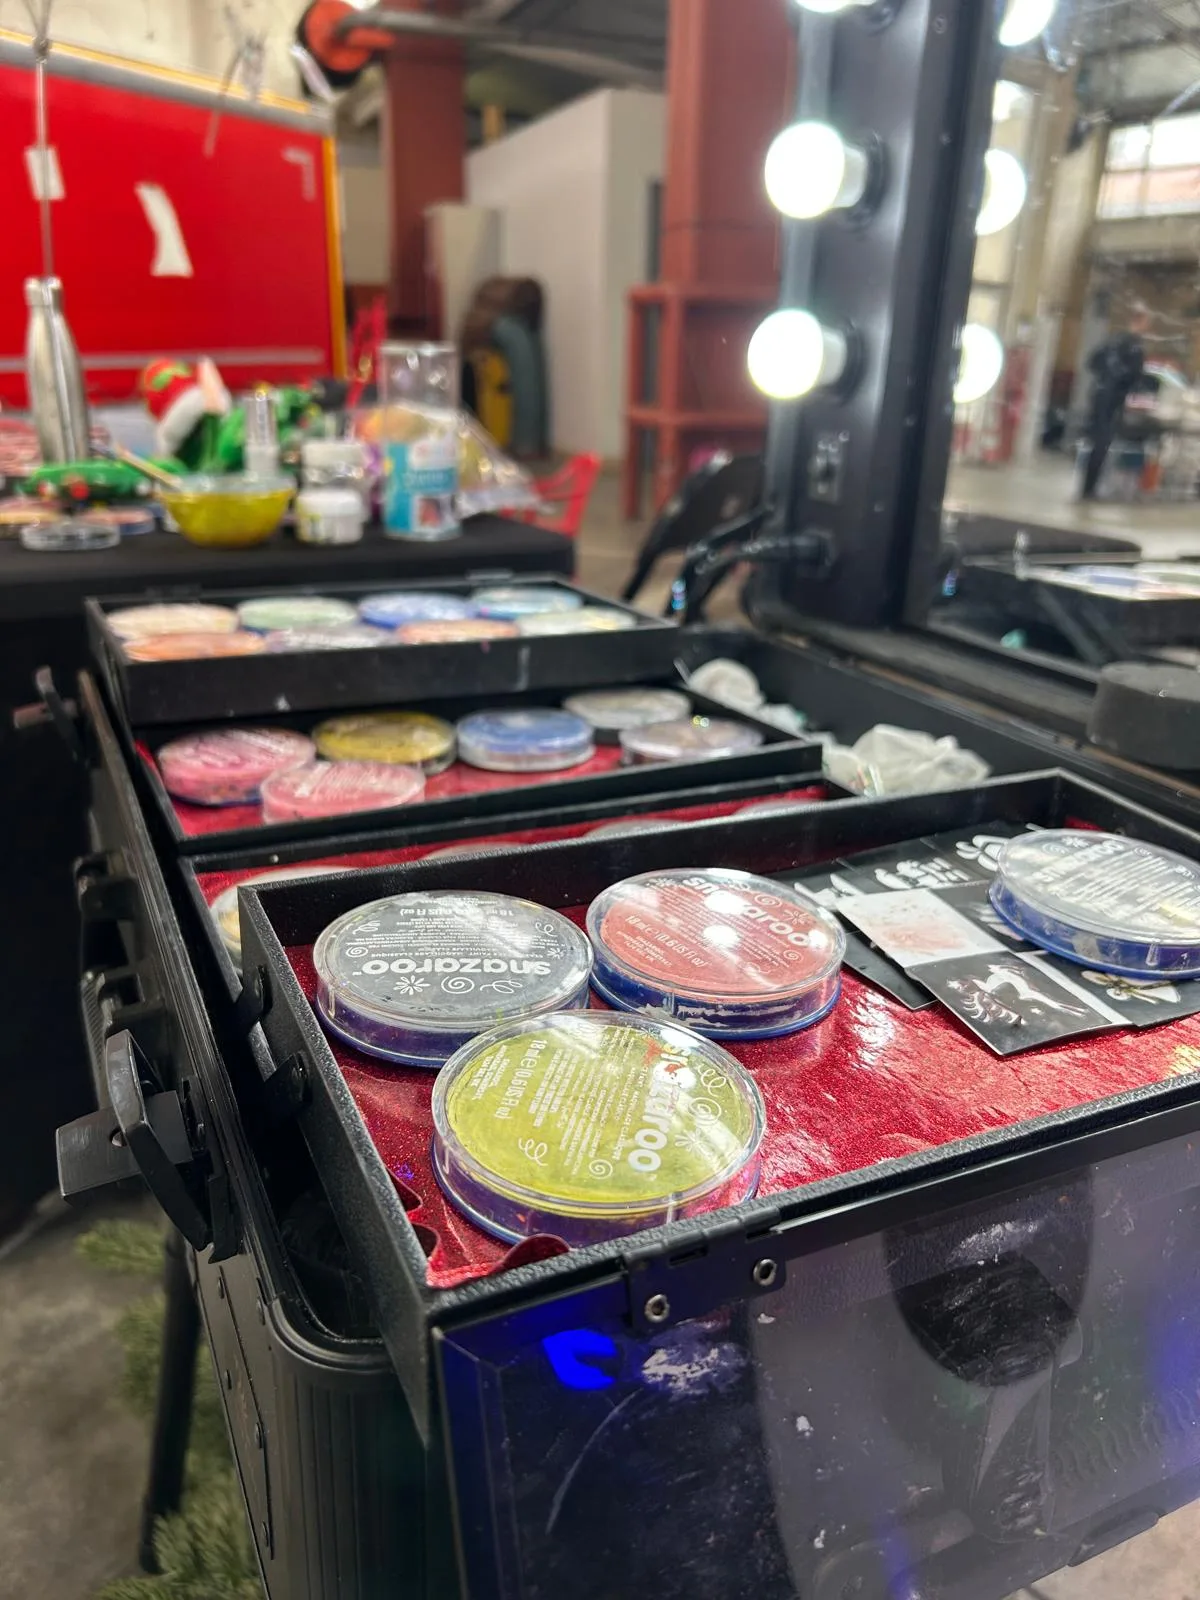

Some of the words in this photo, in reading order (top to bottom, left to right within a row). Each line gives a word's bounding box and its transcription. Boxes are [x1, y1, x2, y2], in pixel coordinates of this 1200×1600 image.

[682, 875, 809, 944] snaroo
[360, 958, 550, 975] snazaroo
[529, 1039, 548, 1049] 18
[509, 1068, 534, 1086] (0.6
[504, 1085, 524, 1097] US
